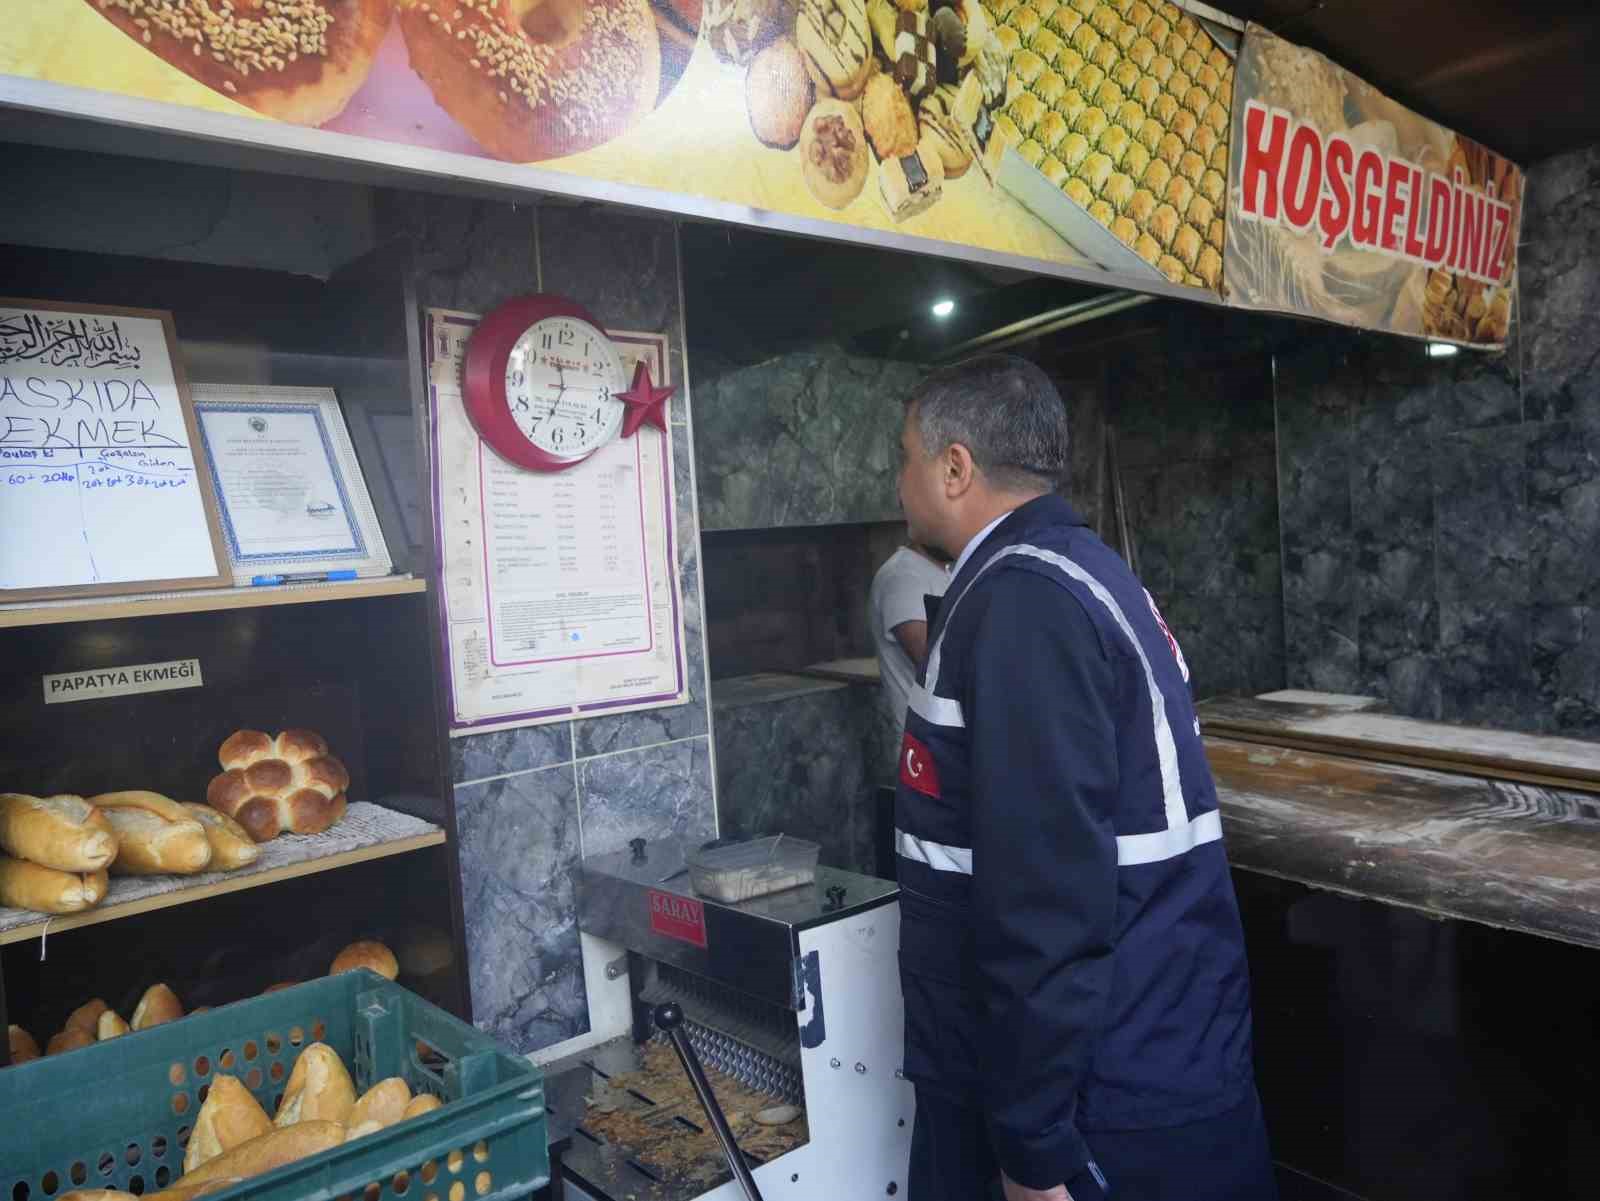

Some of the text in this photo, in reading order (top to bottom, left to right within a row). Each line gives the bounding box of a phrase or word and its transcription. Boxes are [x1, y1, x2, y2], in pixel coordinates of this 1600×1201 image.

[1241, 105, 1512, 283] HOŞGELDİNİZ
[0, 376, 160, 412] ASKIDA
[0, 416, 183, 447] EKMEK
[51, 662, 195, 693] PAPATYA EKMEĞİ
